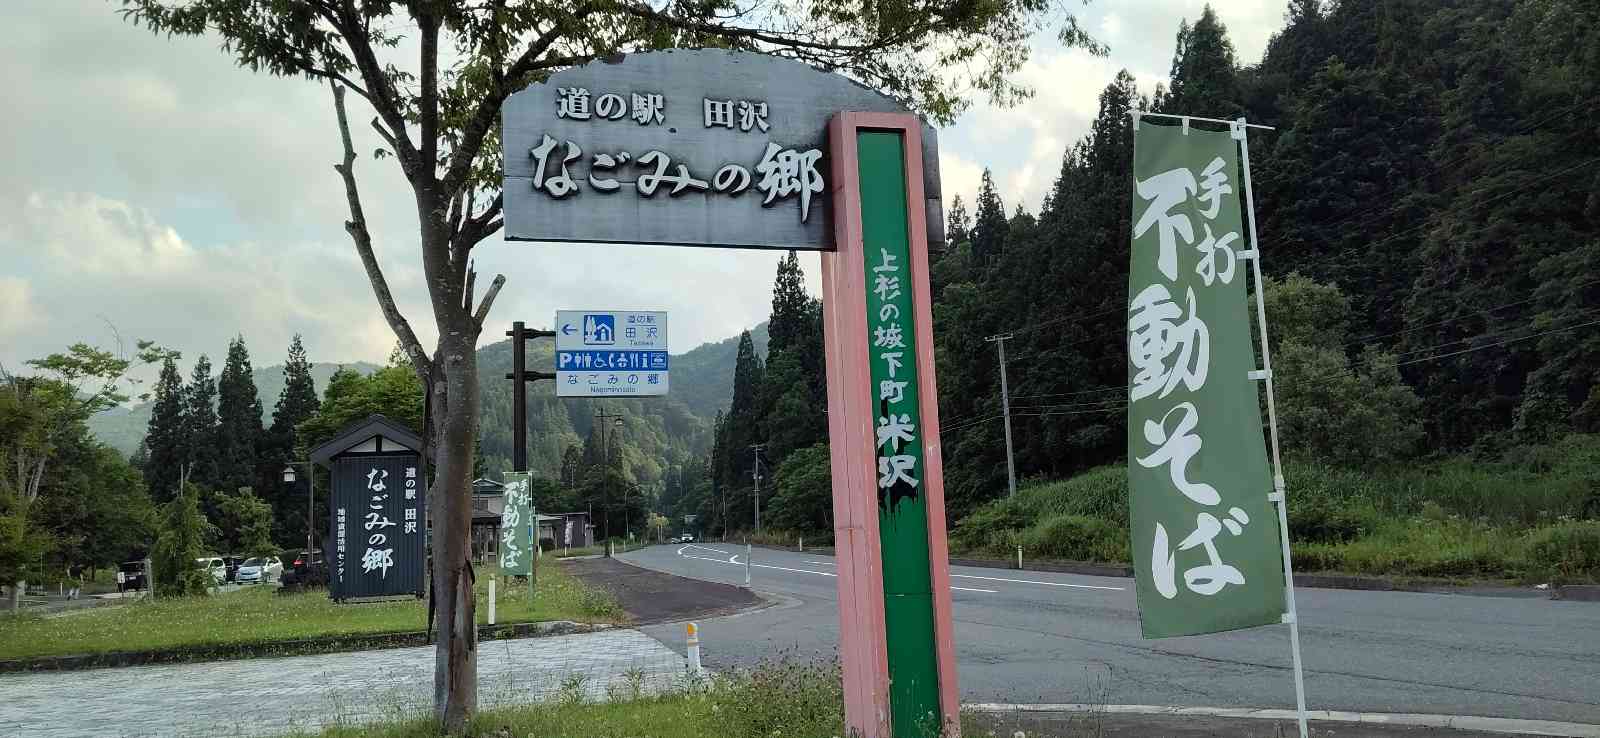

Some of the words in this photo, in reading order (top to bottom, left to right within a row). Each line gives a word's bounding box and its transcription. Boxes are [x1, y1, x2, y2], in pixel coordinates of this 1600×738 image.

[556, 87, 665, 126] 道の駅
[703, 97, 770, 133] 田沢
[530, 133, 825, 224] なごみの郷
[1195, 156, 1239, 287] 手打
[625, 327, 658, 338] 田沢
[873, 248, 907, 403] 上杉の城下町
[1129, 167, 1250, 600] 不動そば
[405, 467, 417, 500] 道の駅
[876, 413, 919, 489] 米沢
[361, 467, 397, 580] なごみの郷
[404, 508, 417, 534] 田沢
[500, 481, 522, 568] 不動そば
